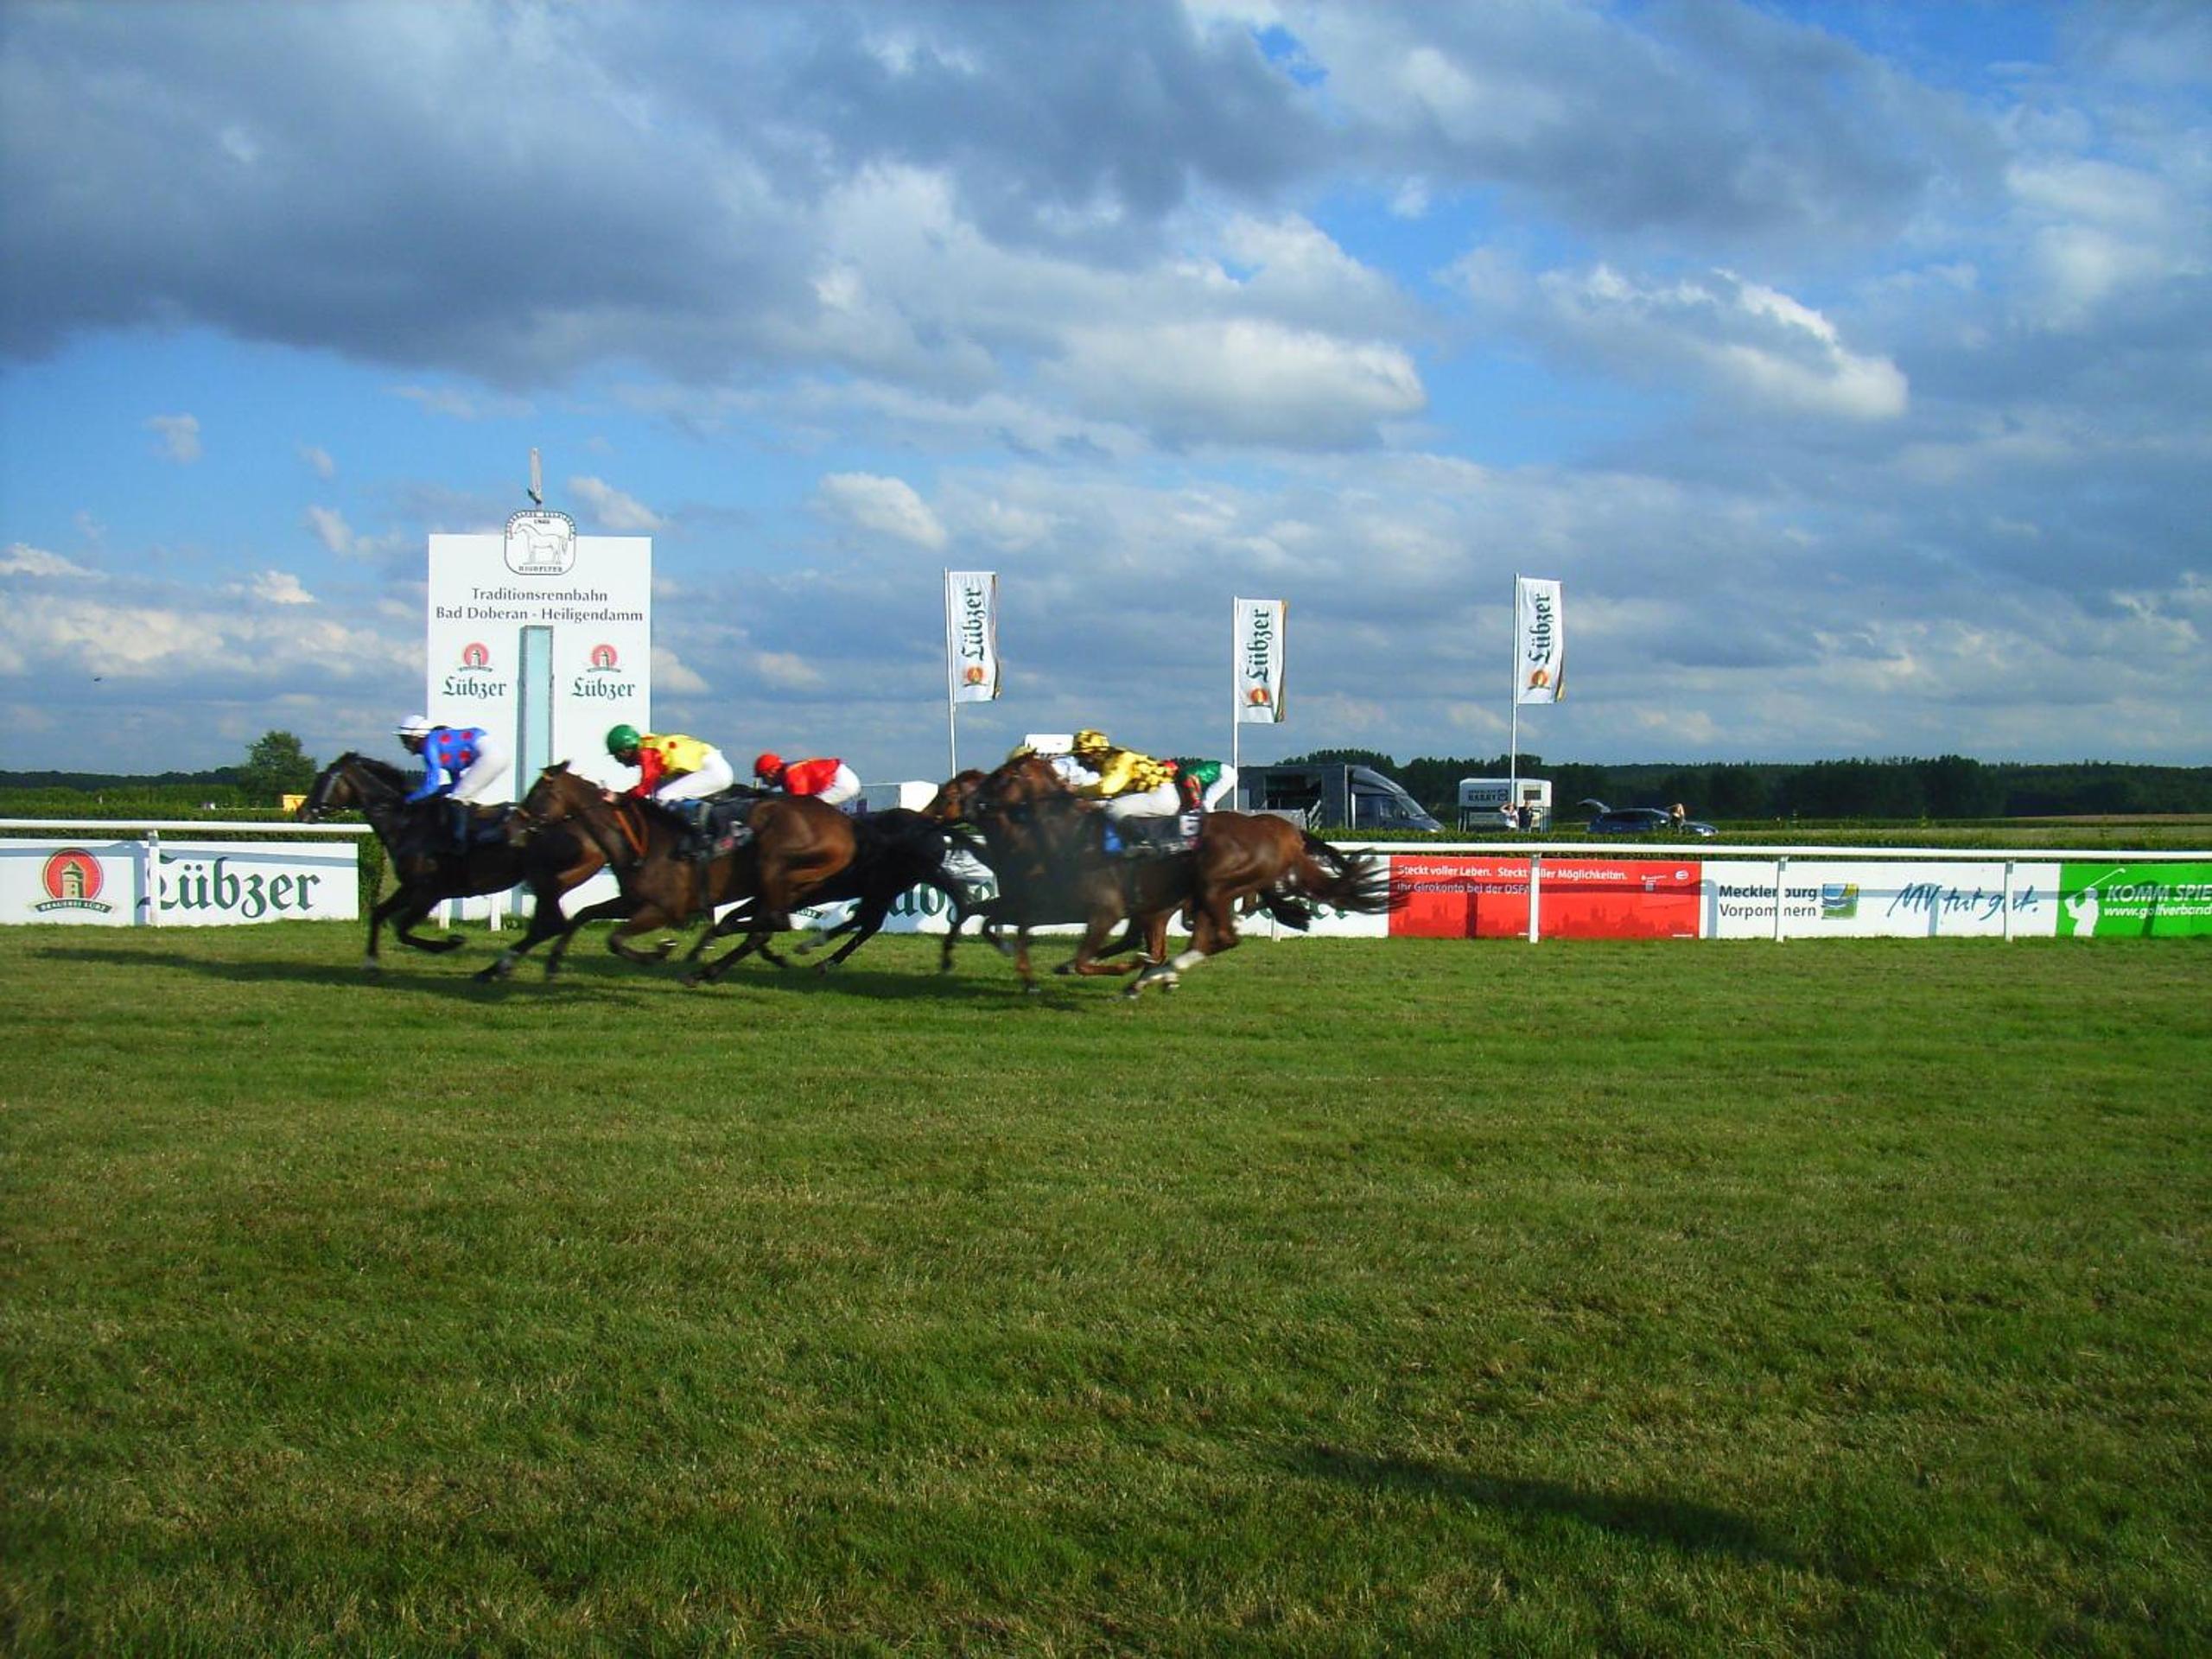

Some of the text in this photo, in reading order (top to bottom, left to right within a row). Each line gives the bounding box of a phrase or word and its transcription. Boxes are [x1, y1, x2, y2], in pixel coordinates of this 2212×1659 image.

[472, 588, 608, 602] Traditionsrennbahn
[436, 607, 462, 619] Bad
[467, 607, 528, 620] Doberan
[542, 607, 643, 623] Heiligendamm
[962, 588, 986, 661] Lübzer
[1528, 594, 1554, 664] Lübzer
[1246, 608, 1273, 683] Lübzer
[442, 676, 507, 698] Lübzer
[571, 677, 636, 699] Lübzer
[1397, 865, 1428, 874] Steckt
[1430, 865, 1458, 875] voller
[1460, 866, 1491, 876] Leben.
[1497, 867, 1528, 877] Steckt
[1558, 868, 1628, 880] Möglichkeiten.
[1414, 883, 1465, 893] Girokonto
[1467, 883, 1483, 893] bei
[1486, 884, 1502, 893] der
[2106, 885, 2170, 902] KOMM
[1887, 883, 1942, 917] MV
[1944, 887, 1984, 914] tut
